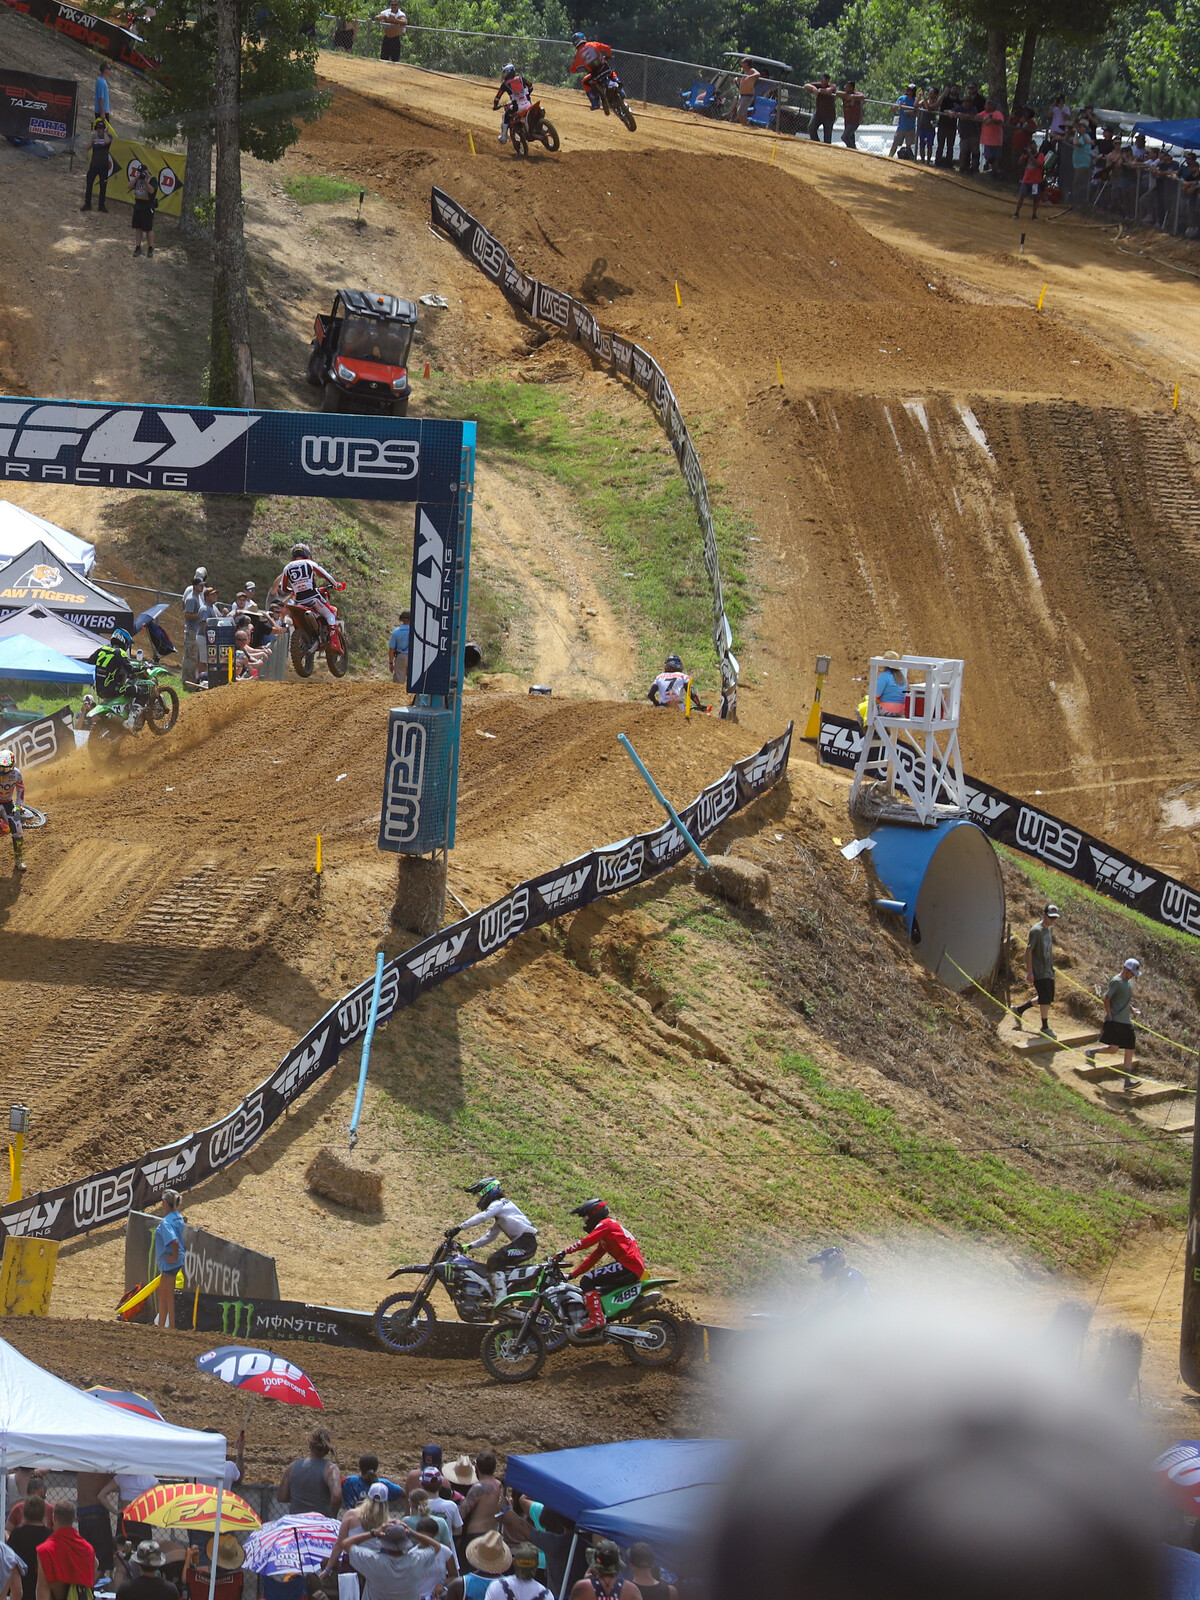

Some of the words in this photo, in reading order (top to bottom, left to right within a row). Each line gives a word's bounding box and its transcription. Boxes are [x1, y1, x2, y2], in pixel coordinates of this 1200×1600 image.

[10, 97, 48, 111] TAZER
[29, 126, 67, 138] UNLIMITED
[30, 118, 67, 133] PARTS
[434, 195, 471, 233] FLY
[472, 226, 505, 278] WPS
[505, 260, 532, 297] FLY
[540, 286, 569, 326] WPS
[5, 461, 188, 486] RACING
[301, 435, 420, 480] WPS
[288, 565, 312, 580] 51
[34, 588, 87, 604] TIGERS
[411, 507, 444, 688] FLY
[440, 548, 453, 651] RACING
[96, 651, 116, 668] 21
[665, 678, 677, 692] 7
[744, 734, 791, 783] FLY
[752, 763, 782, 789] RACING
[384, 720, 427, 842] WPS
[697, 771, 738, 836] WPS
[1016, 807, 1083, 869] WPS
[537, 865, 592, 906] FLY
[597, 840, 646, 894] WPS
[1089, 845, 1157, 894] FLY
[1095, 874, 1136, 899] RACING
[479, 887, 530, 953] WPS
[548, 892, 579, 911] RACING
[1160, 881, 1200, 938] WP
[407, 927, 472, 979] FLY
[420, 957, 456, 984] RACING
[338, 967, 400, 1044] WPS
[272, 1026, 331, 1095] FLY
[284, 1059, 321, 1101] RACING
[209, 1092, 265, 1168] WPS
[141, 1143, 202, 1187] FLY
[152, 1173, 188, 1193] RACING
[1, 1198, 66, 1237] FLY
[74, 1167, 135, 1229] WPS
[185, 1243, 241, 1297] ONSTER
[593, 1261, 624, 1278] FXR
[256, 1314, 338, 1336] MONSTER
[267, 1330, 325, 1344] ENERGY
[213, 1353, 303, 1383] 100
[262, 1377, 306, 1398] 100Percent
